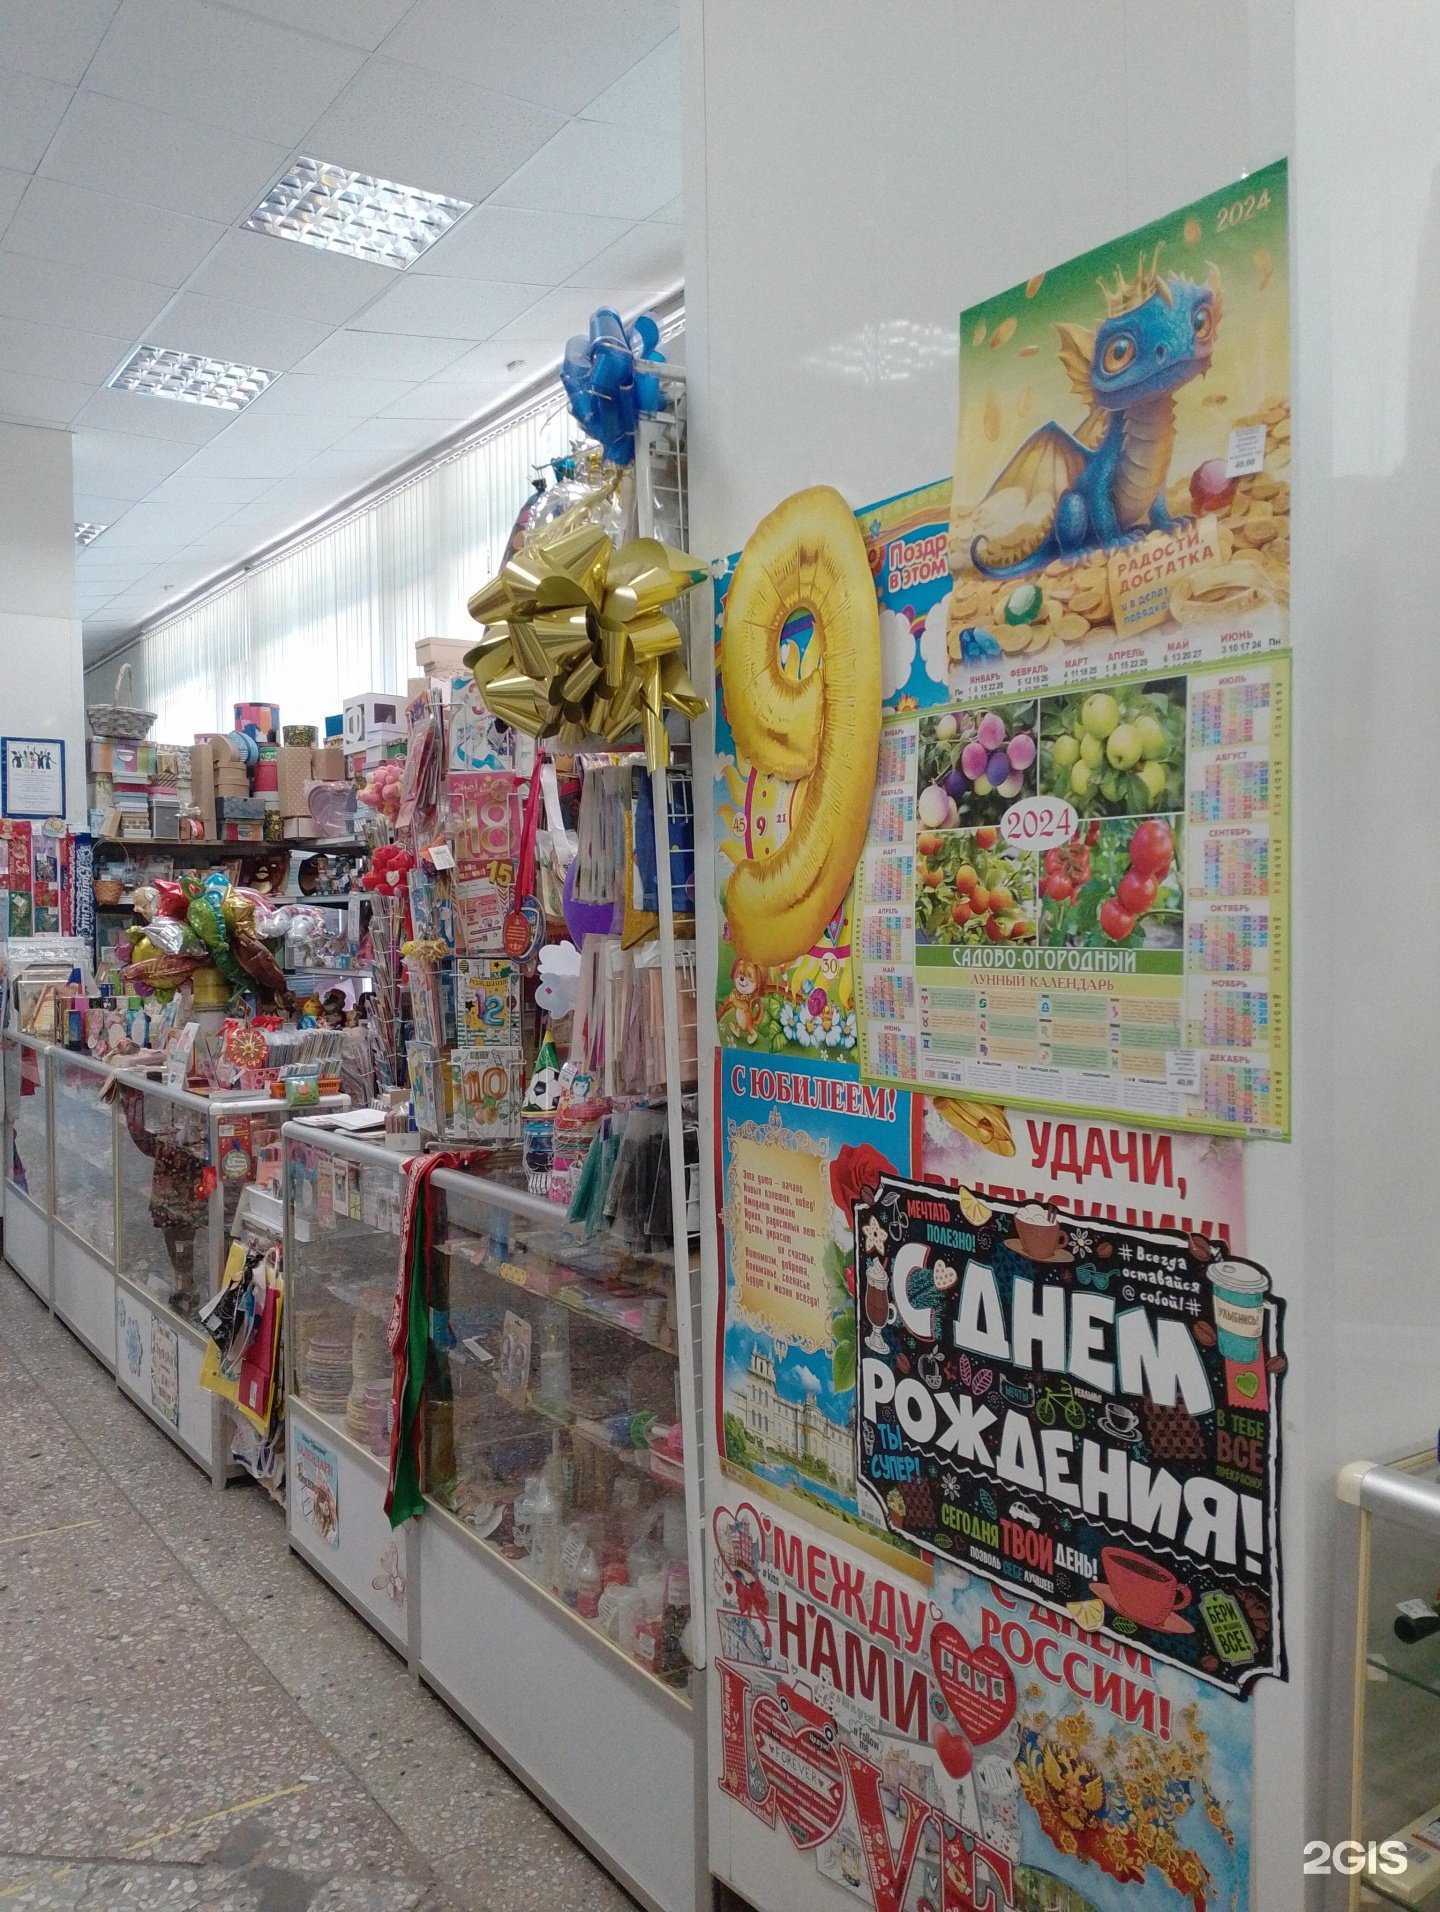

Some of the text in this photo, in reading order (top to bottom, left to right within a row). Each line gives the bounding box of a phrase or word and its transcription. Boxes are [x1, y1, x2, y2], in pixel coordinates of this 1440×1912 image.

[1215, 188, 1271, 233] 2024
[1120, 545, 1215, 594] ДОСТАТКА
[1009, 664, 1049, 678] ФЕВРАЛЬ
[1064, 657, 1089, 668] МАРТ
[1107, 649, 1145, 662] АПРЕЛЬ
[969, 673, 1001, 685] ЯНВАРЬ
[1007, 807, 1072, 840] 2024
[952, 947, 1137, 973] САДОВО-ОГОРОДНЫЙ
[970, 973, 1115, 992] ЛУННЫЙ КАЛЕНДАРЬ
[731, 1064, 747, 1097] С
[750, 1067, 897, 1122] ЮБИЛЕЕМ!
[1026, 1119, 1187, 1200] УДАЧИ,
[907, 1199, 951, 1223] МЕЧТАТЬ
[926, 1223, 976, 1253] ПОЛЕЗНО!
[1121, 1267, 1201, 1294] оставайся
[891, 1242, 936, 1342] С
[952, 1259, 1215, 1416] ДНЕМ
[876, 1422, 903, 1452] ТЫ
[1216, 1408, 1265, 1441] В ТЕБЕ
[862, 1357, 1264, 1576] РОЖДЕНИЯ!
[1216, 1428, 1264, 1474] ВСЕ
[869, 1453, 922, 1484] СУПЕР!
[940, 1502, 1099, 1582] СЕГОДНЯ ТВОЙ ДЕНЬ!
[969, 1545, 1001, 1570] ПОЗВОЛЬ
[1023, 1572, 1055, 1595] ЛУЧШЕЕ!
[770, 1529, 926, 1655] МЕЖДУ
[1206, 1602, 1238, 1624] БЕРИ
[1216, 1629, 1251, 1655] ВСЕ!
[777, 1592, 931, 1742] НАМИ
[979, 1606, 1174, 1744] РОССИИ!
